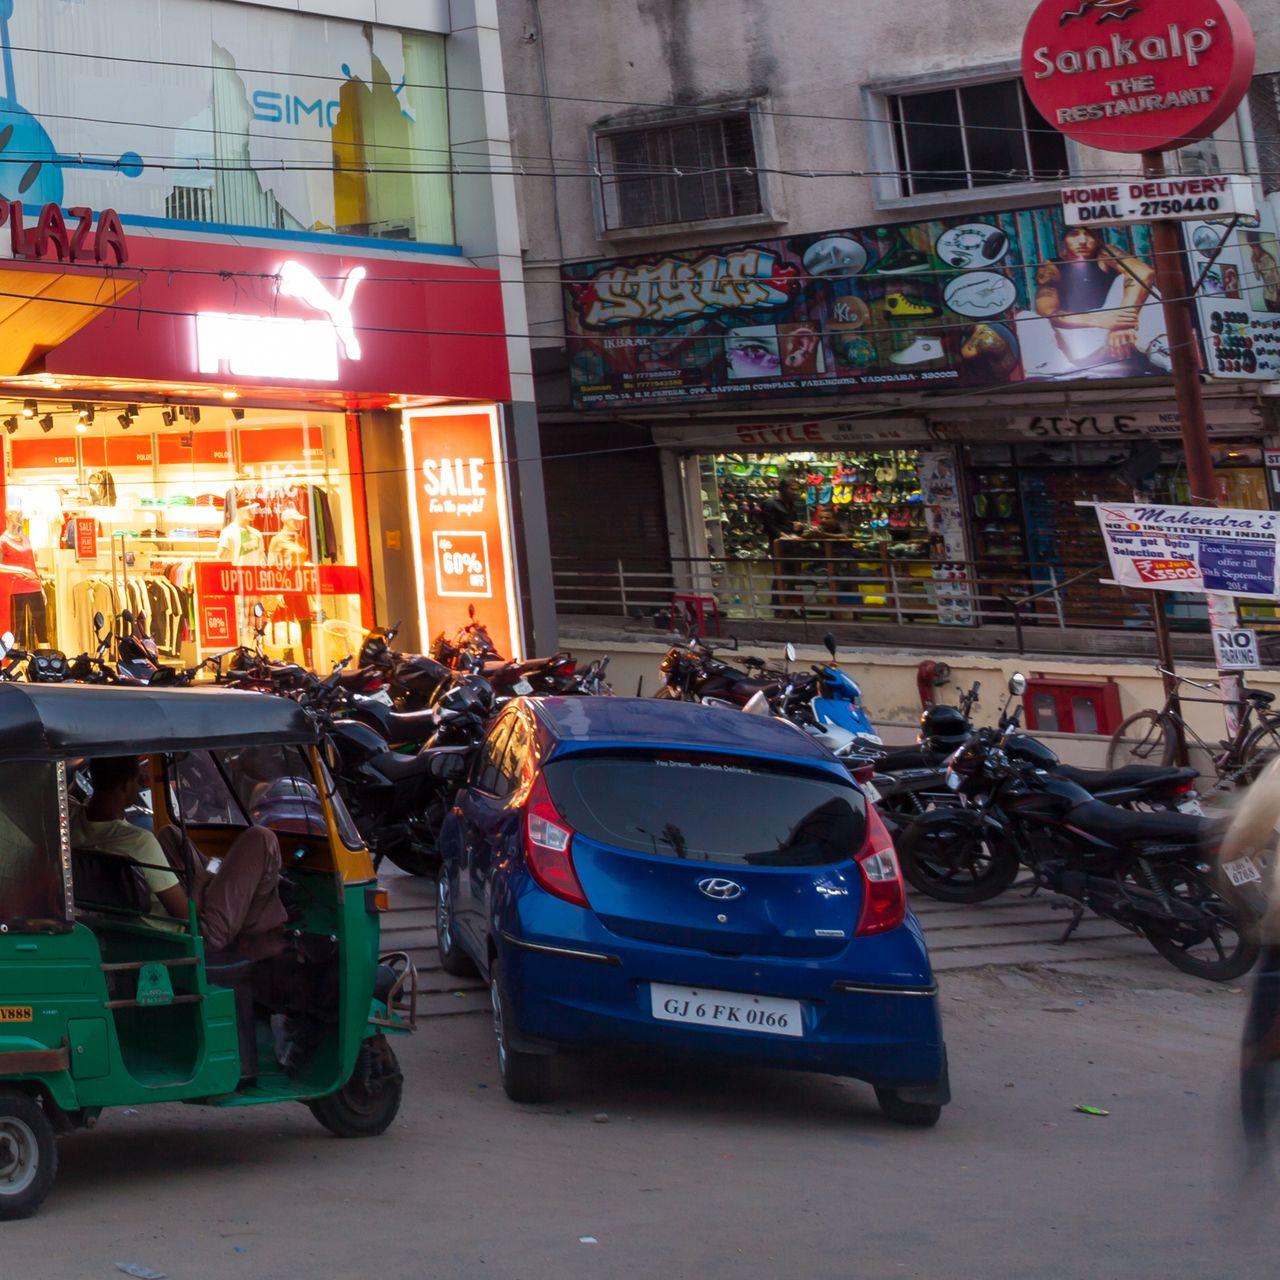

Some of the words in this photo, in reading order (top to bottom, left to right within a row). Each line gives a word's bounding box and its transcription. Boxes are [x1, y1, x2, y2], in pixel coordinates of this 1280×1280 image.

[1033, 23, 1213, 80] Sankalp
[1105, 75, 1156, 97] THE
[1056, 86, 1213, 125] RESTAURANT
[1063, 187, 1120, 205] HOME
[1129, 177, 1229, 200] DELIVERY
[1078, 204, 1124, 221] DIAL
[1140, 197, 1219, 217] 2750440
[736, 422, 825, 445] STYLE
[1029, 415, 1141, 436] STYLE
[422, 458, 487, 496] SALE
[1133, 507, 1275, 530] Mahendra's
[1143, 524, 1214, 536] INSTITUTE
[1217, 529, 1232, 537] IN
[1235, 531, 1277, 540] INDIA
[1113, 546, 1165, 559] Selection
[1201, 544, 1243, 557] Teachers
[1244, 547, 1276, 558] month
[1217, 559, 1241, 568] offer
[1218, 632, 1251, 648] NO
[1218, 648, 1255, 665] PARKING
[663, 998, 691, 1019] GJ
[695, 1001, 706, 1018] 6
[711, 1004, 742, 1023] FK
[745, 1008, 789, 1029] 0166
